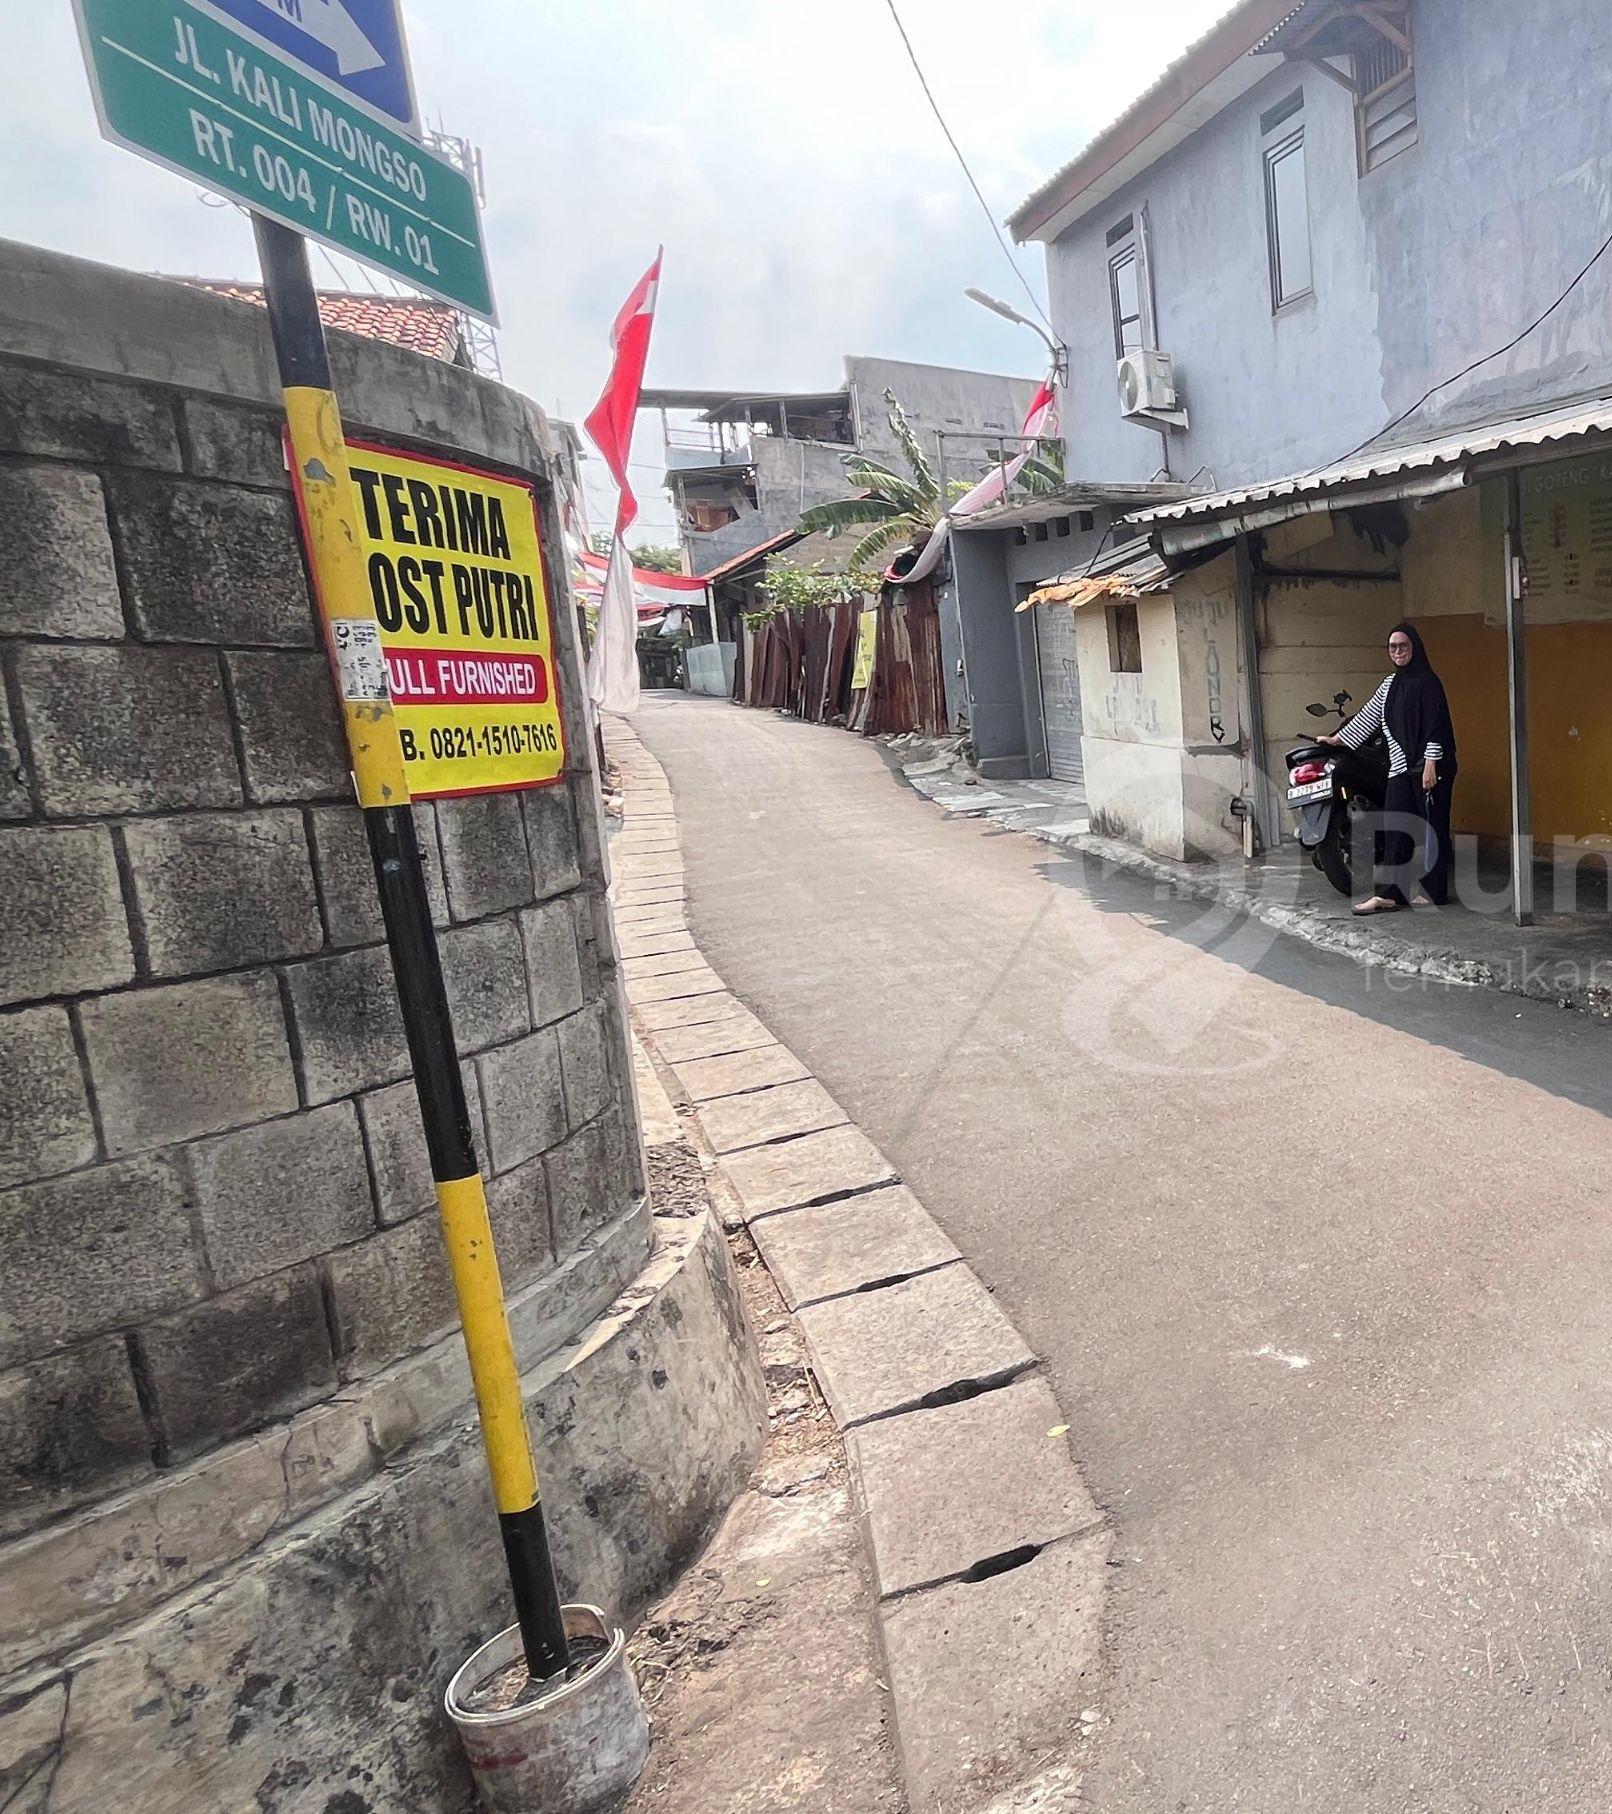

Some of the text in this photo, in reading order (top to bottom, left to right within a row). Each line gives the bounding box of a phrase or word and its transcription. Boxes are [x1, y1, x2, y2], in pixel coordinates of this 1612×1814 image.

[173, 15, 427, 202] JL. KALI MONGSO
[188, 108, 248, 178] RT.
[253, 144, 316, 214] 004
[346, 193, 401, 257] RW.
[404, 226, 440, 276] 01
[348, 466, 511, 560] TERIMA
[1534, 467, 1589, 492] GORENG
[368, 552, 539, 641] OST PUTRI
[386, 657, 436, 696] ULL
[437, 659, 536, 696] FURNISHED
[399, 723, 558, 762] B. 0821-1510-7616
